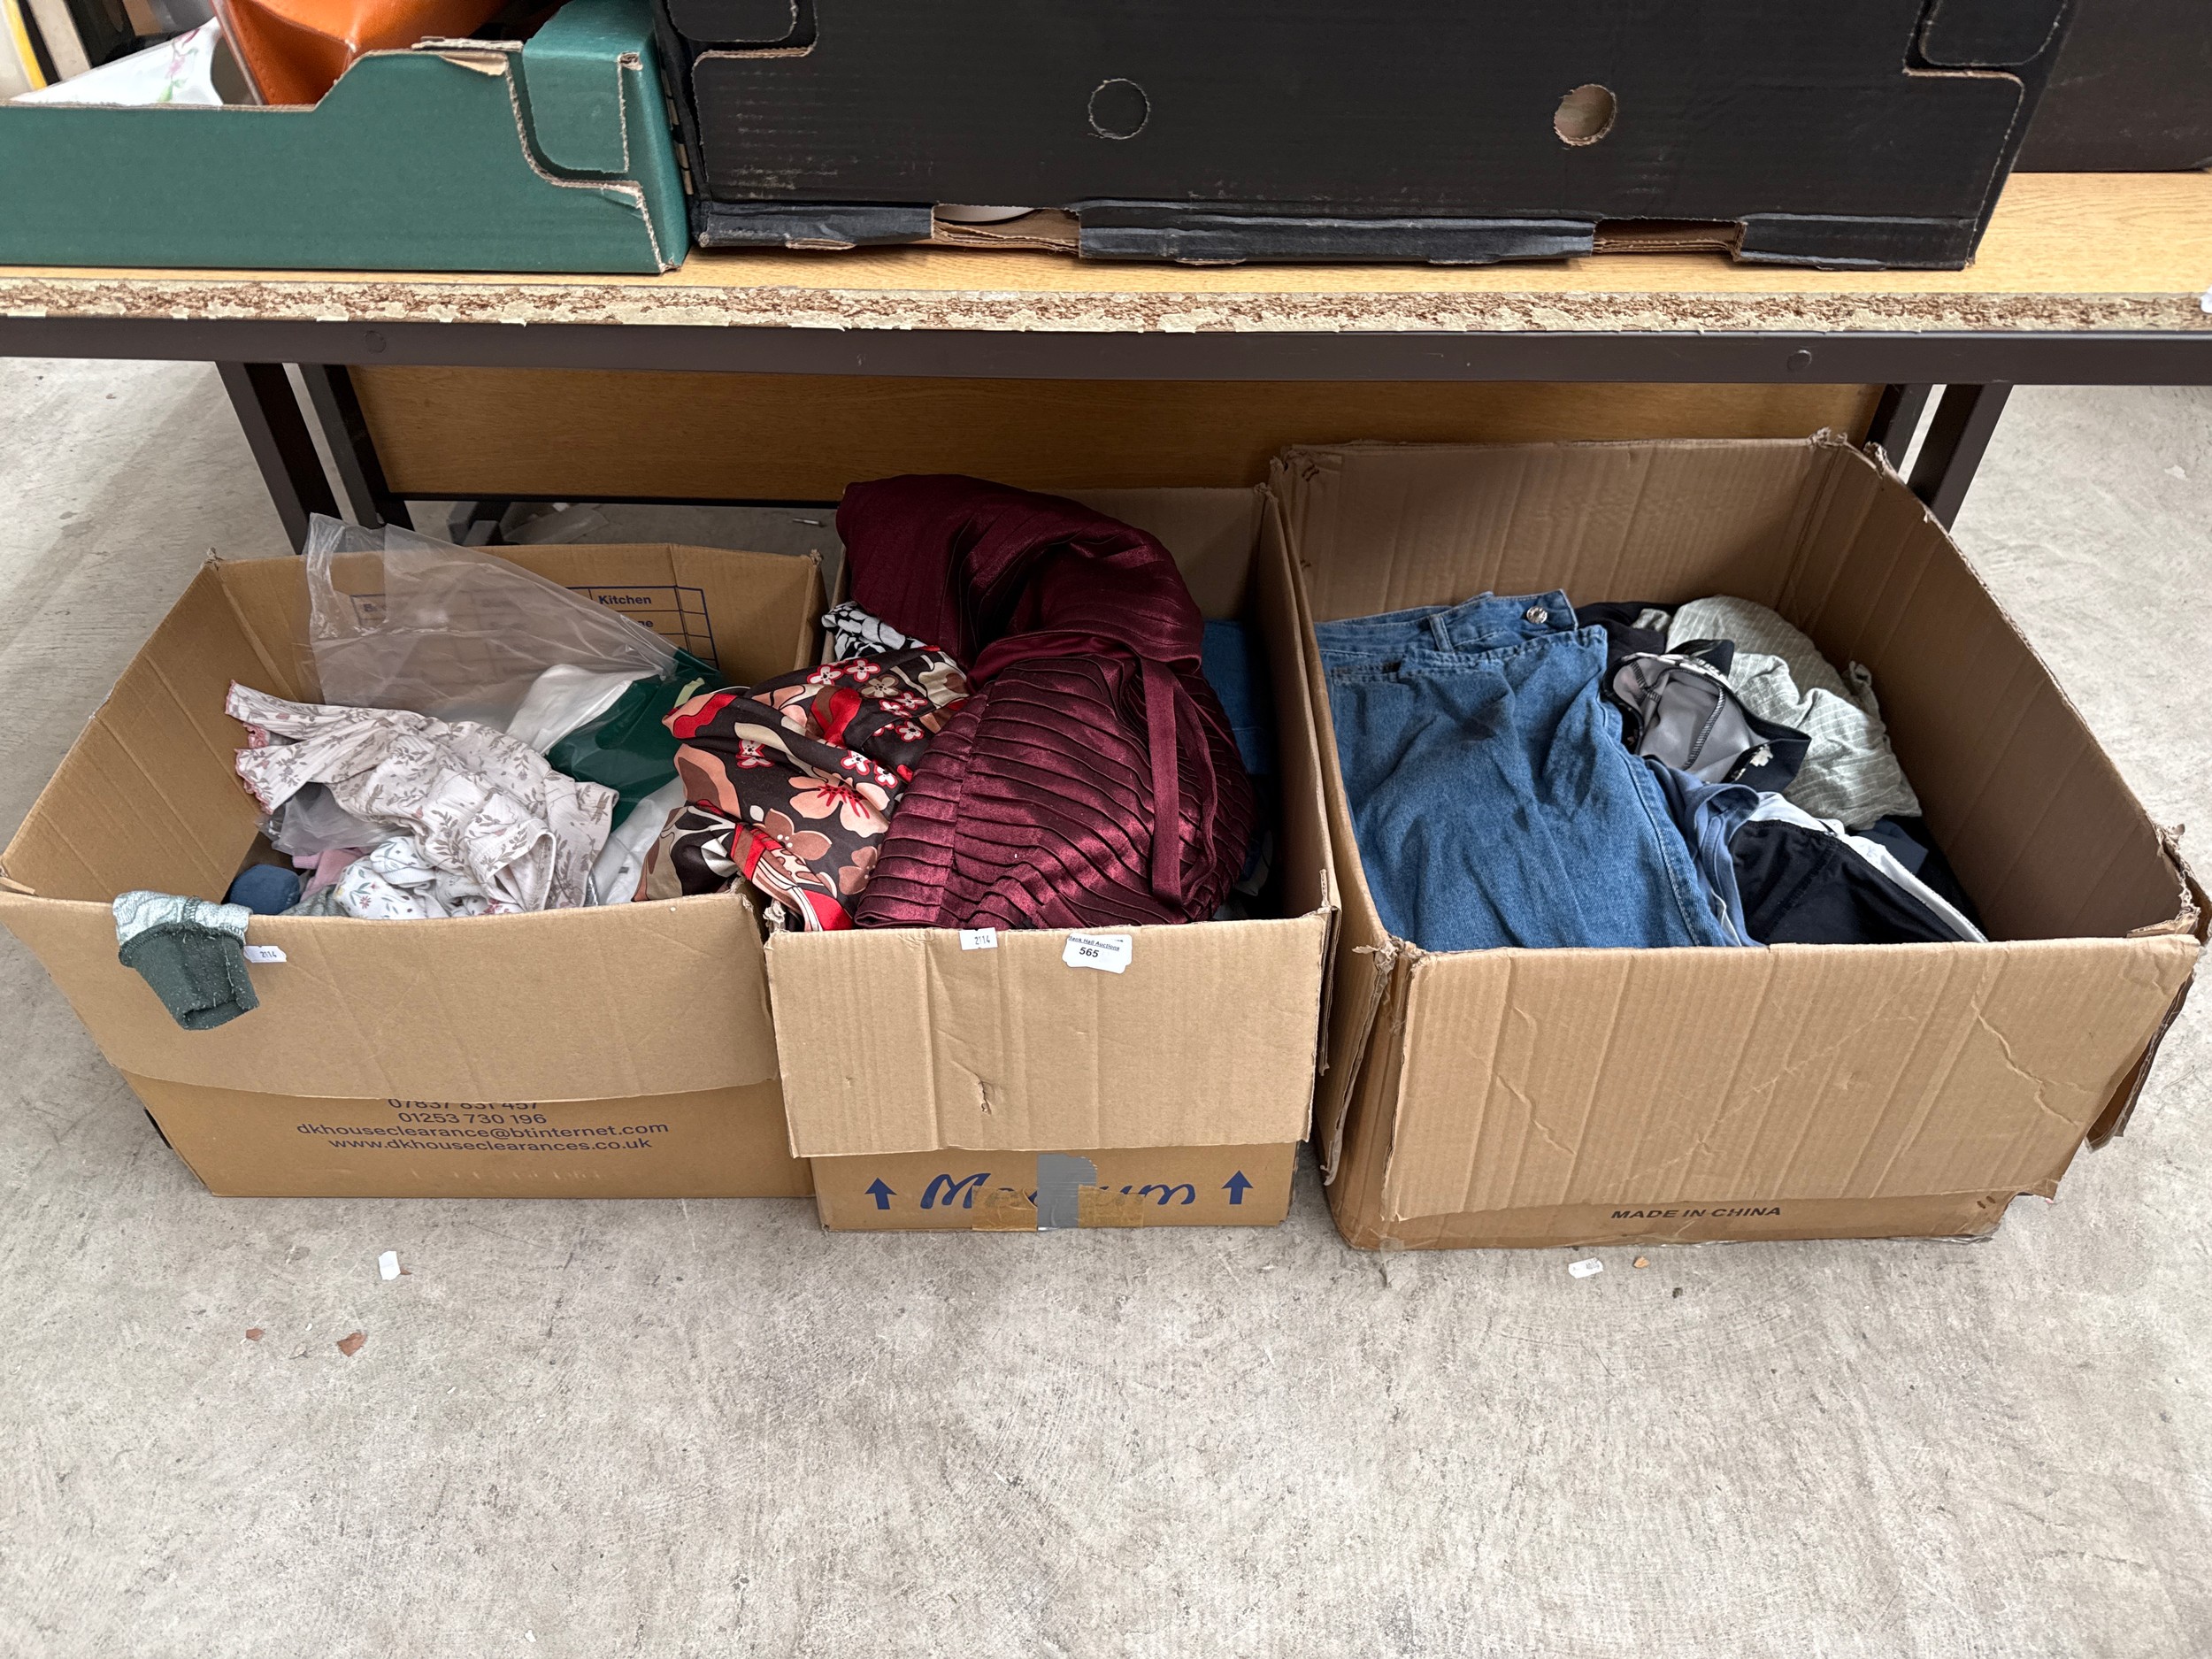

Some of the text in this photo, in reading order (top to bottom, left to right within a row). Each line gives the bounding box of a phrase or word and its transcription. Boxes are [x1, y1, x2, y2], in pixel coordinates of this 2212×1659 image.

[598, 595, 652, 605] Kitchen
[1079, 946, 1099, 957] 565
[1095, 941, 1120, 952] Auctions
[398, 1112, 547, 1125] 01253 730 196
[296, 1123, 669, 1141] dkhouseclearance@btinternet.com
[328, 1137, 652, 1151] www.dkhouseclearances.co.uk
[1610, 1206, 1781, 1219] MADE IN CHINA
